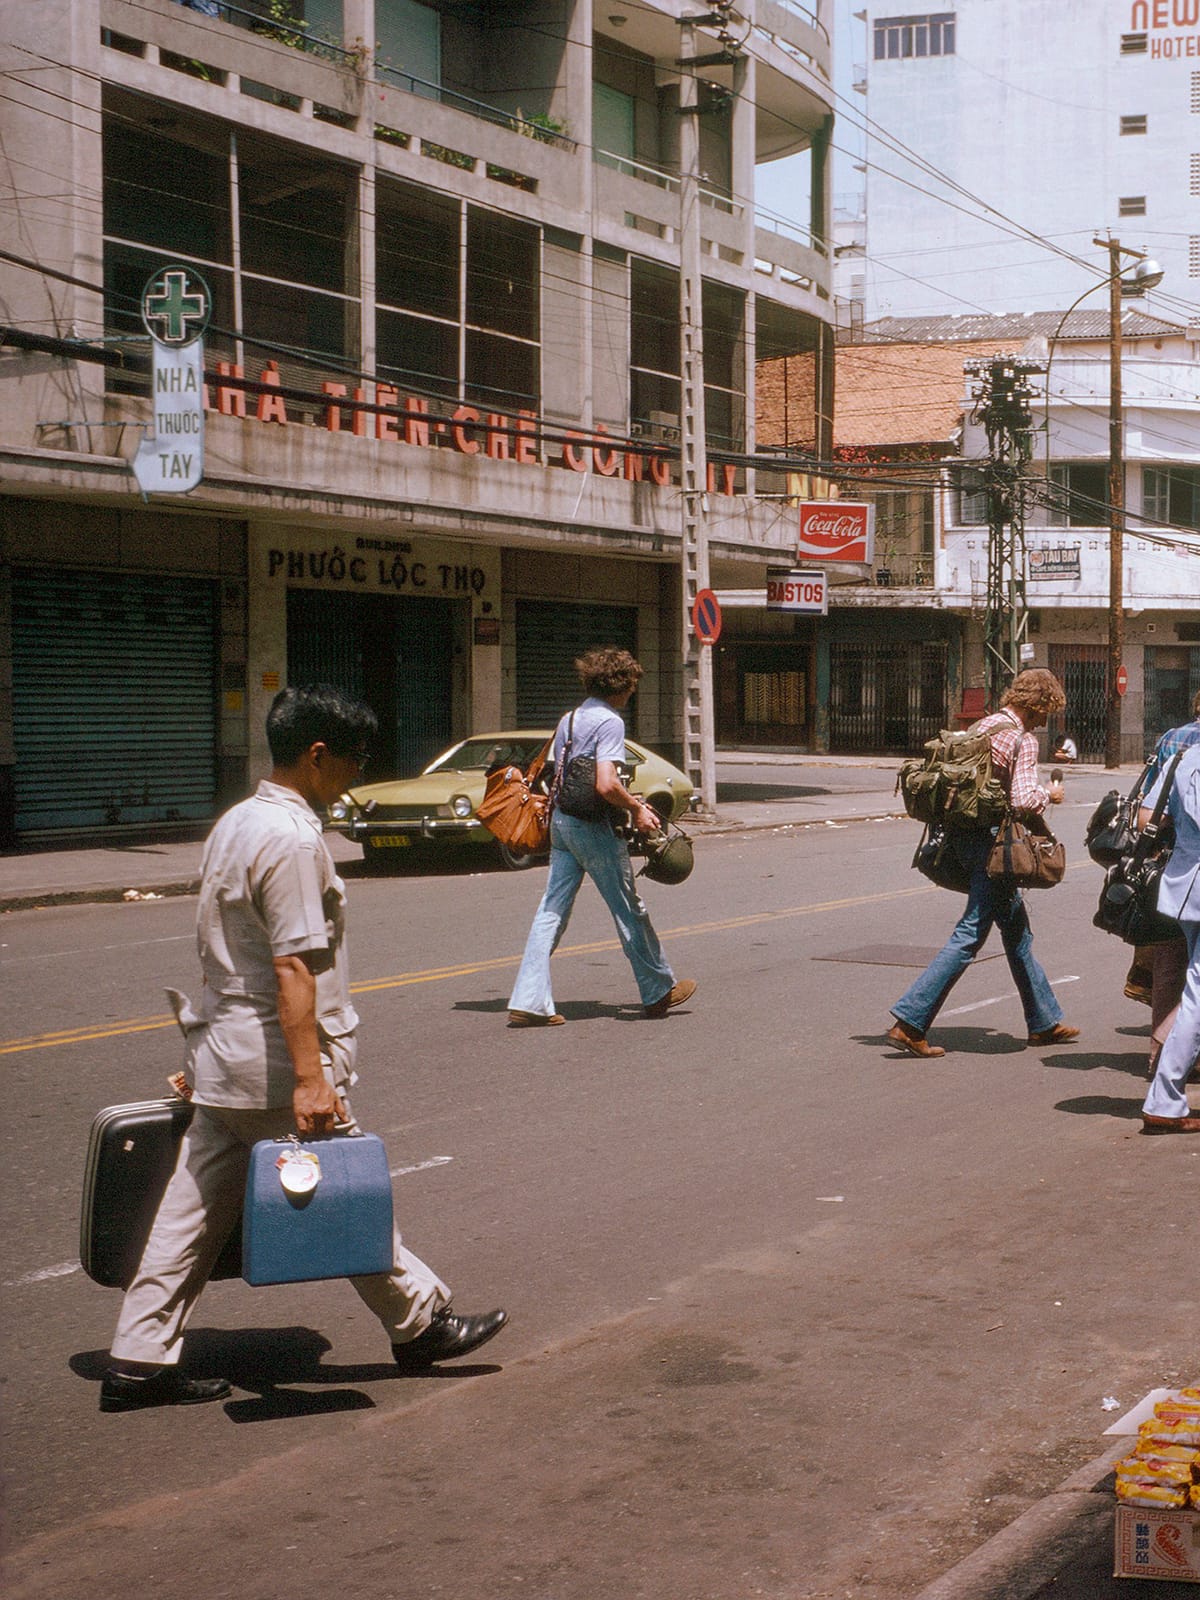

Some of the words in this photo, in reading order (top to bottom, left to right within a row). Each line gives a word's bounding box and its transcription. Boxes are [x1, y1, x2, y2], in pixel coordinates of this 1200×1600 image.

[157, 362, 197, 393] NHÀ
[157, 408, 200, 434] THUỐC
[159, 450, 193, 479] TÂY
[803, 513, 864, 540] Coca-Cola
[768, 582, 823, 603] BASTOS
